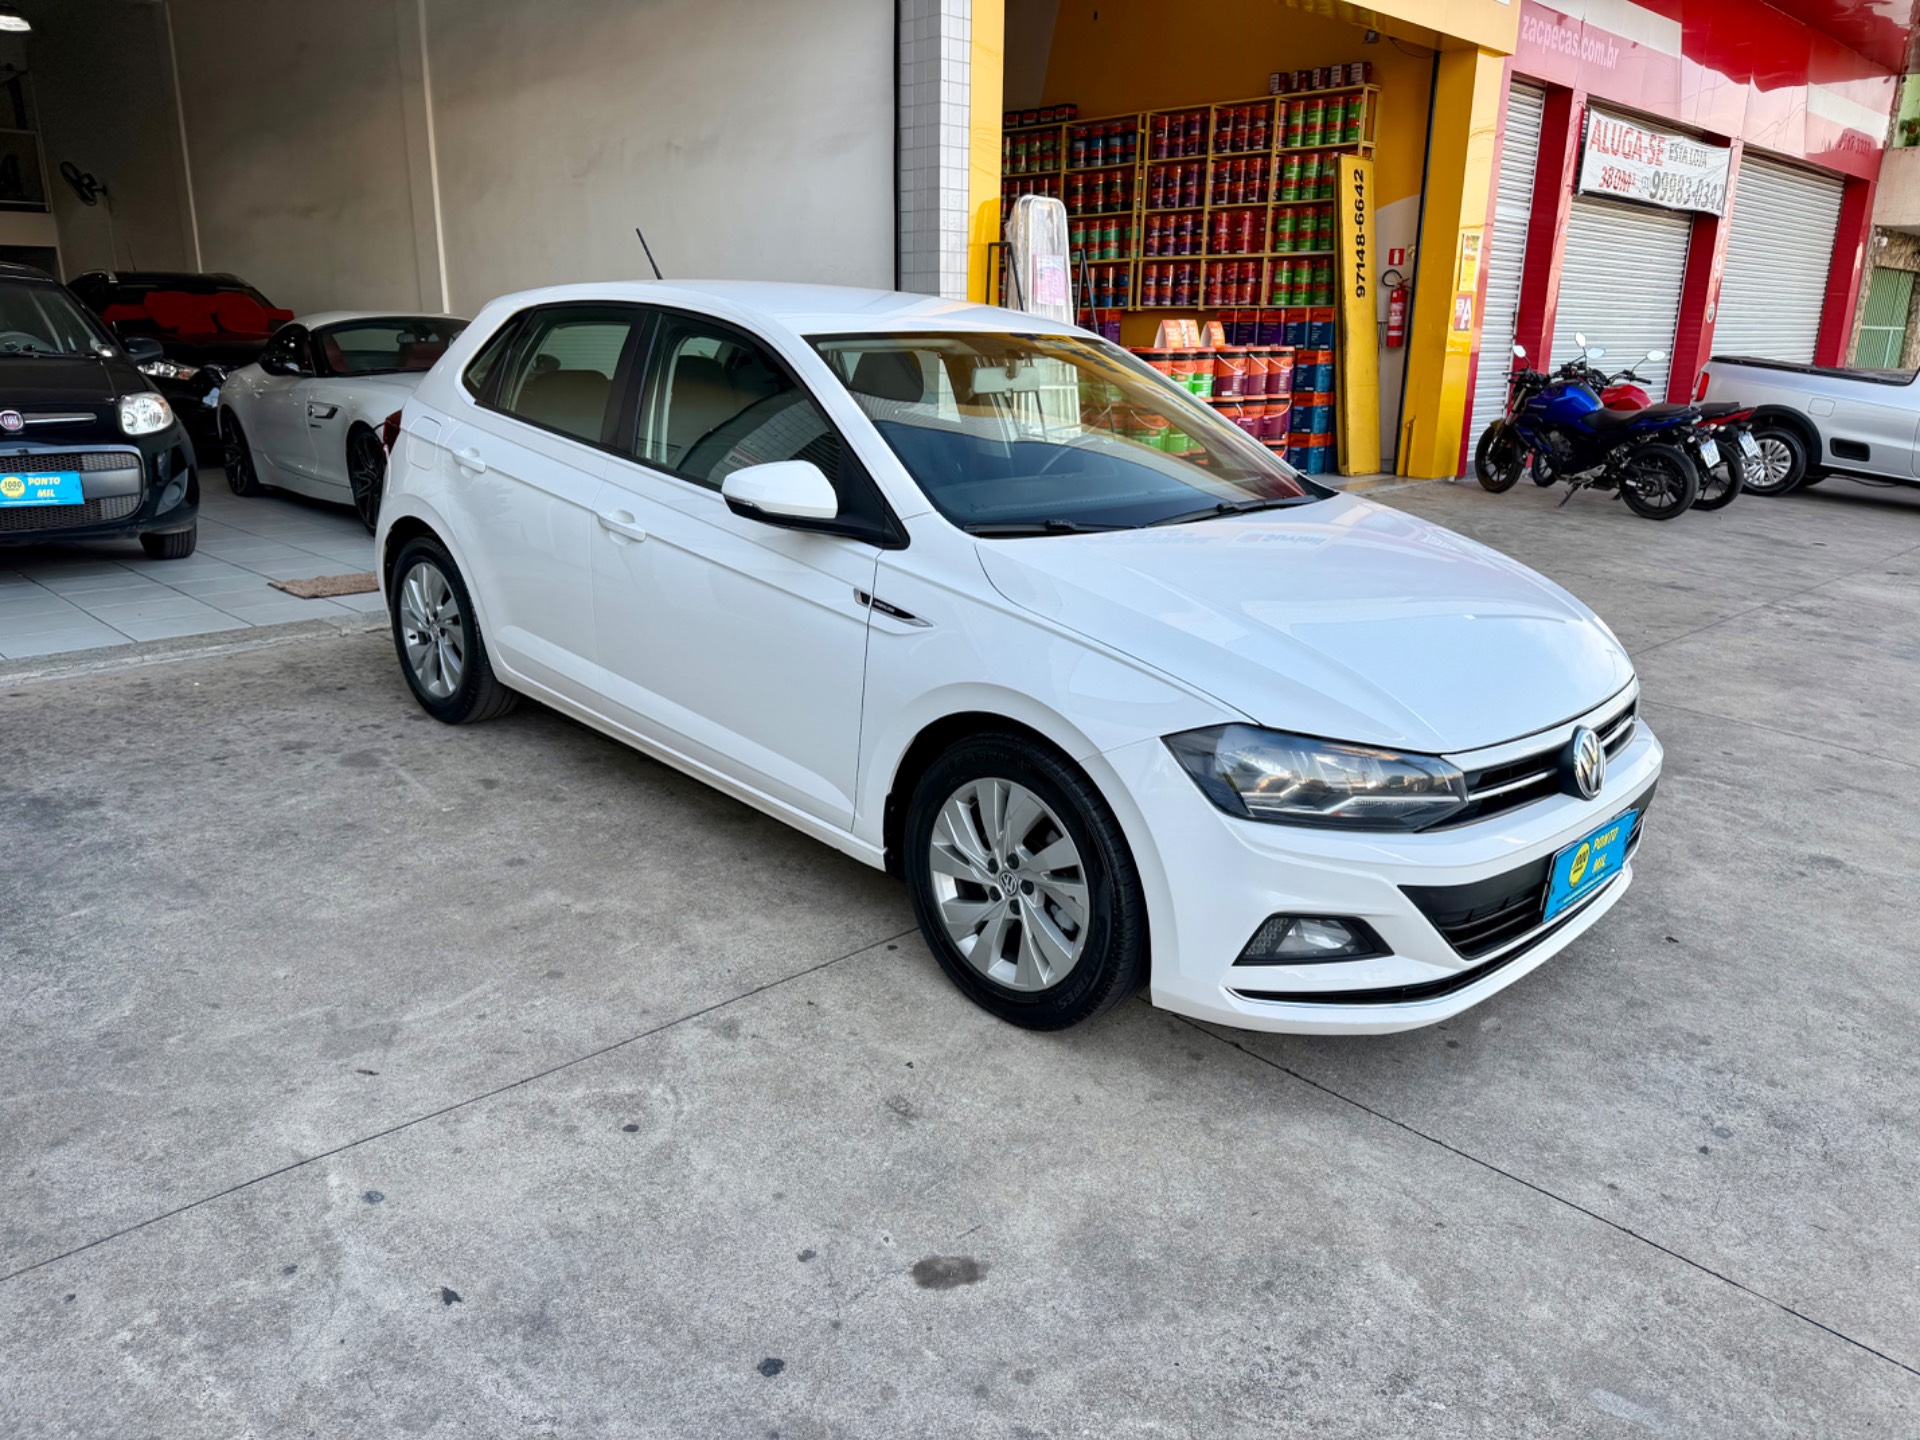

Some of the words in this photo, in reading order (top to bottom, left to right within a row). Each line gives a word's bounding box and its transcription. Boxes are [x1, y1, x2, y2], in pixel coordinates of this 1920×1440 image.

[1588, 119, 1665, 167] ALUGA-SE
[1354, 169, 1366, 298] 97148-6642
[28, 476, 61, 486] PONTO
[37, 489, 56, 498] MIL
[1592, 826, 1620, 853] PONTO
